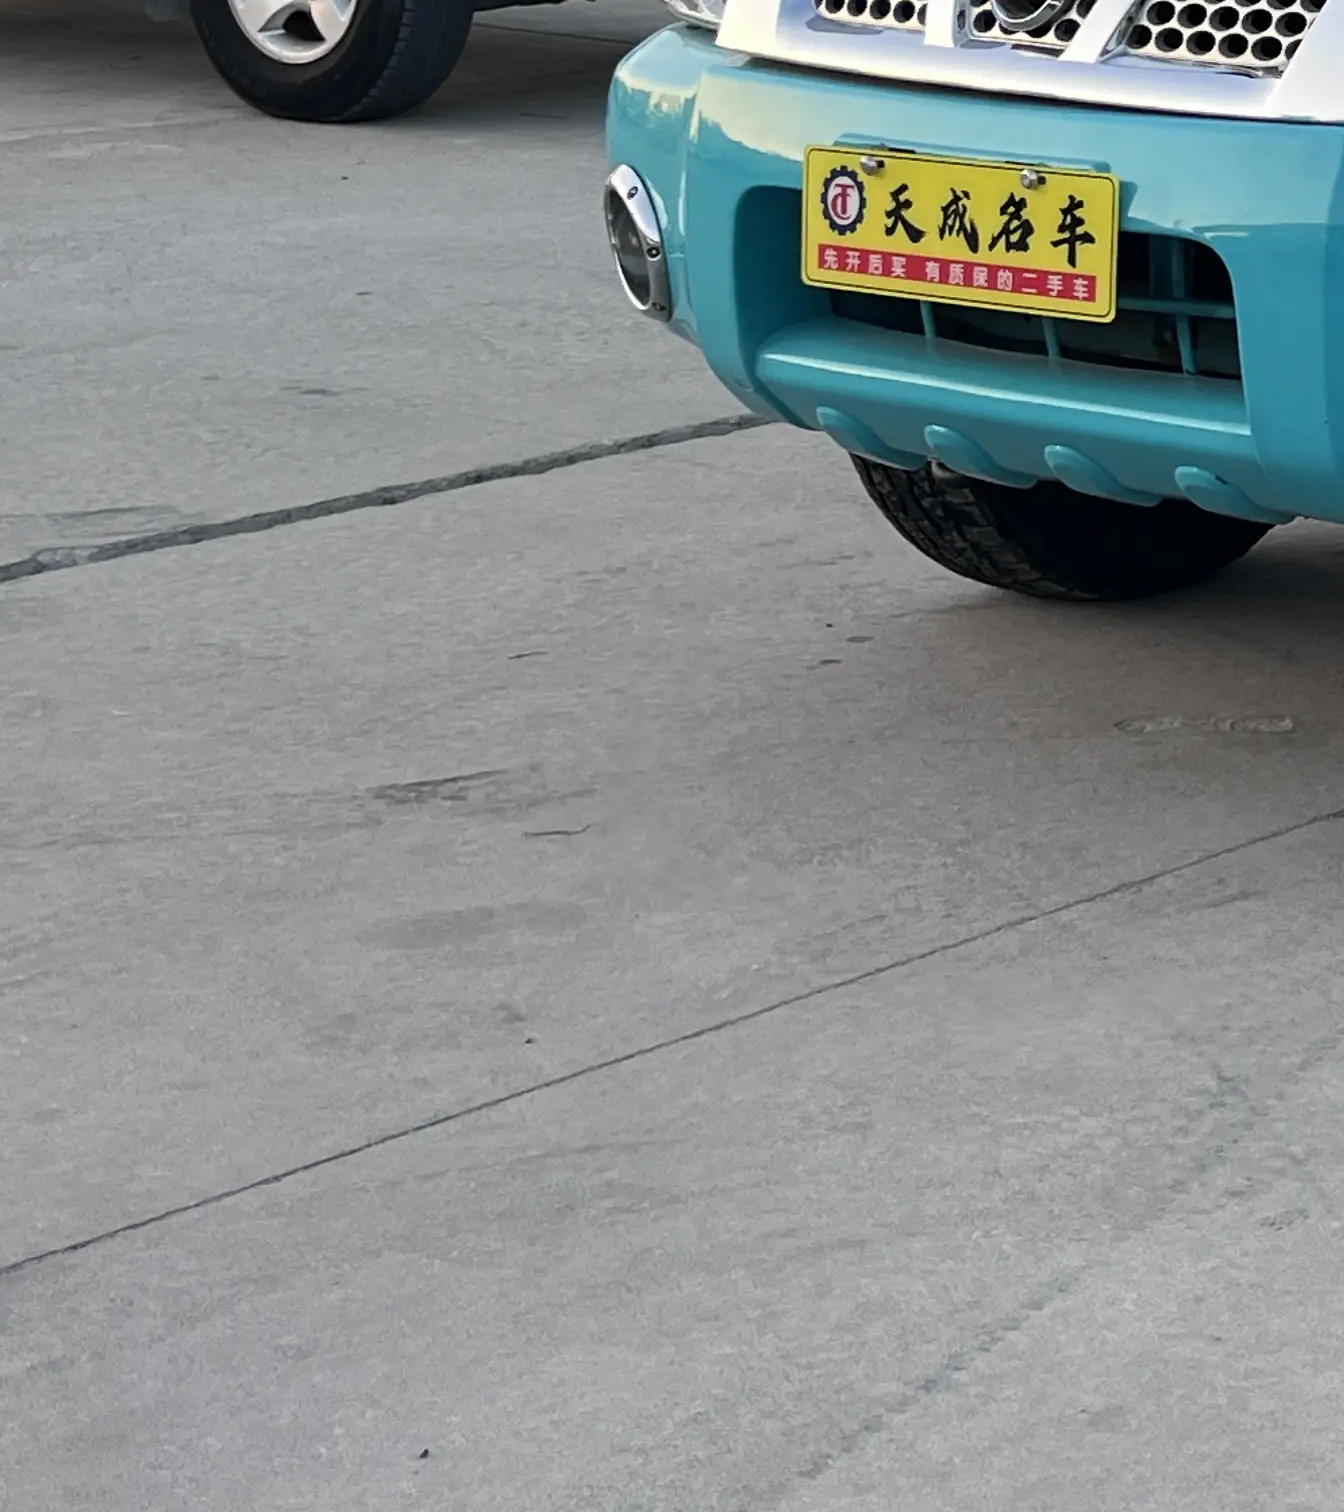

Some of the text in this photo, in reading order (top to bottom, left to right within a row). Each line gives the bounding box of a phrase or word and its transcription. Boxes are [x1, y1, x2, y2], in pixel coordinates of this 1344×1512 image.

[884, 183, 1095, 268] 天成名车
[823, 247, 1090, 300] 先开后买 有质保的二手车
